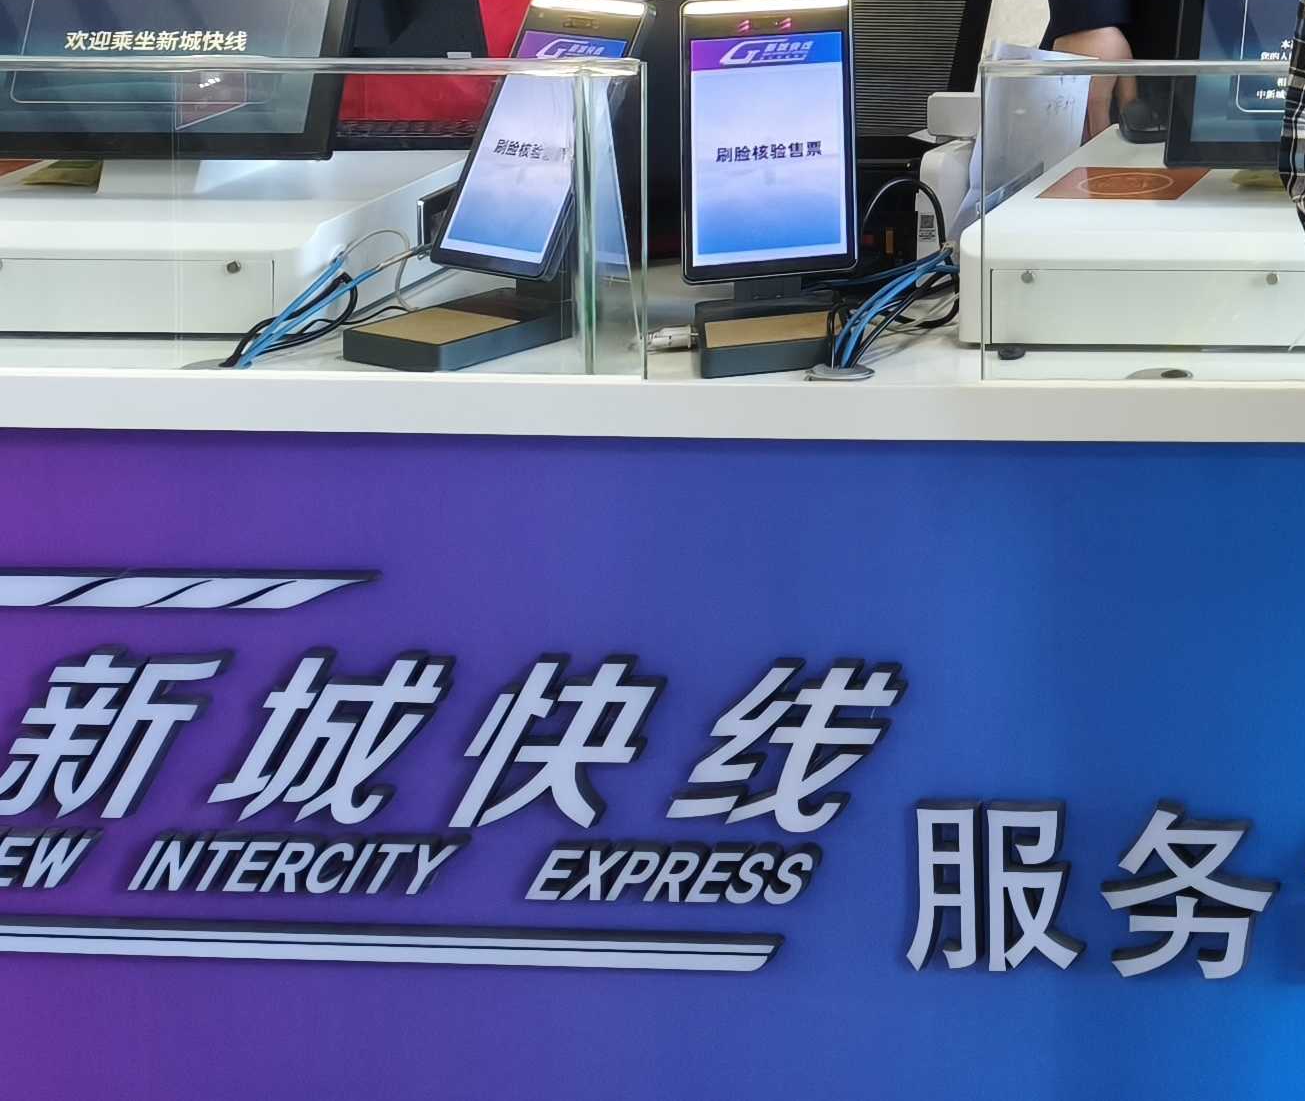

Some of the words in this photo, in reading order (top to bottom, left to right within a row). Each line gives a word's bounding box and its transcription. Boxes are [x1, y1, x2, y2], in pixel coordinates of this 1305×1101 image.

[64, 29, 248, 52] 欢迎乘坐新城快线
[715, 140, 822, 163] 刷脸核验售票
[0, 651, 904, 835] 新城快线
[128, 840, 458, 895] INTERCITY
[525, 849, 814, 905] EXPRESS
